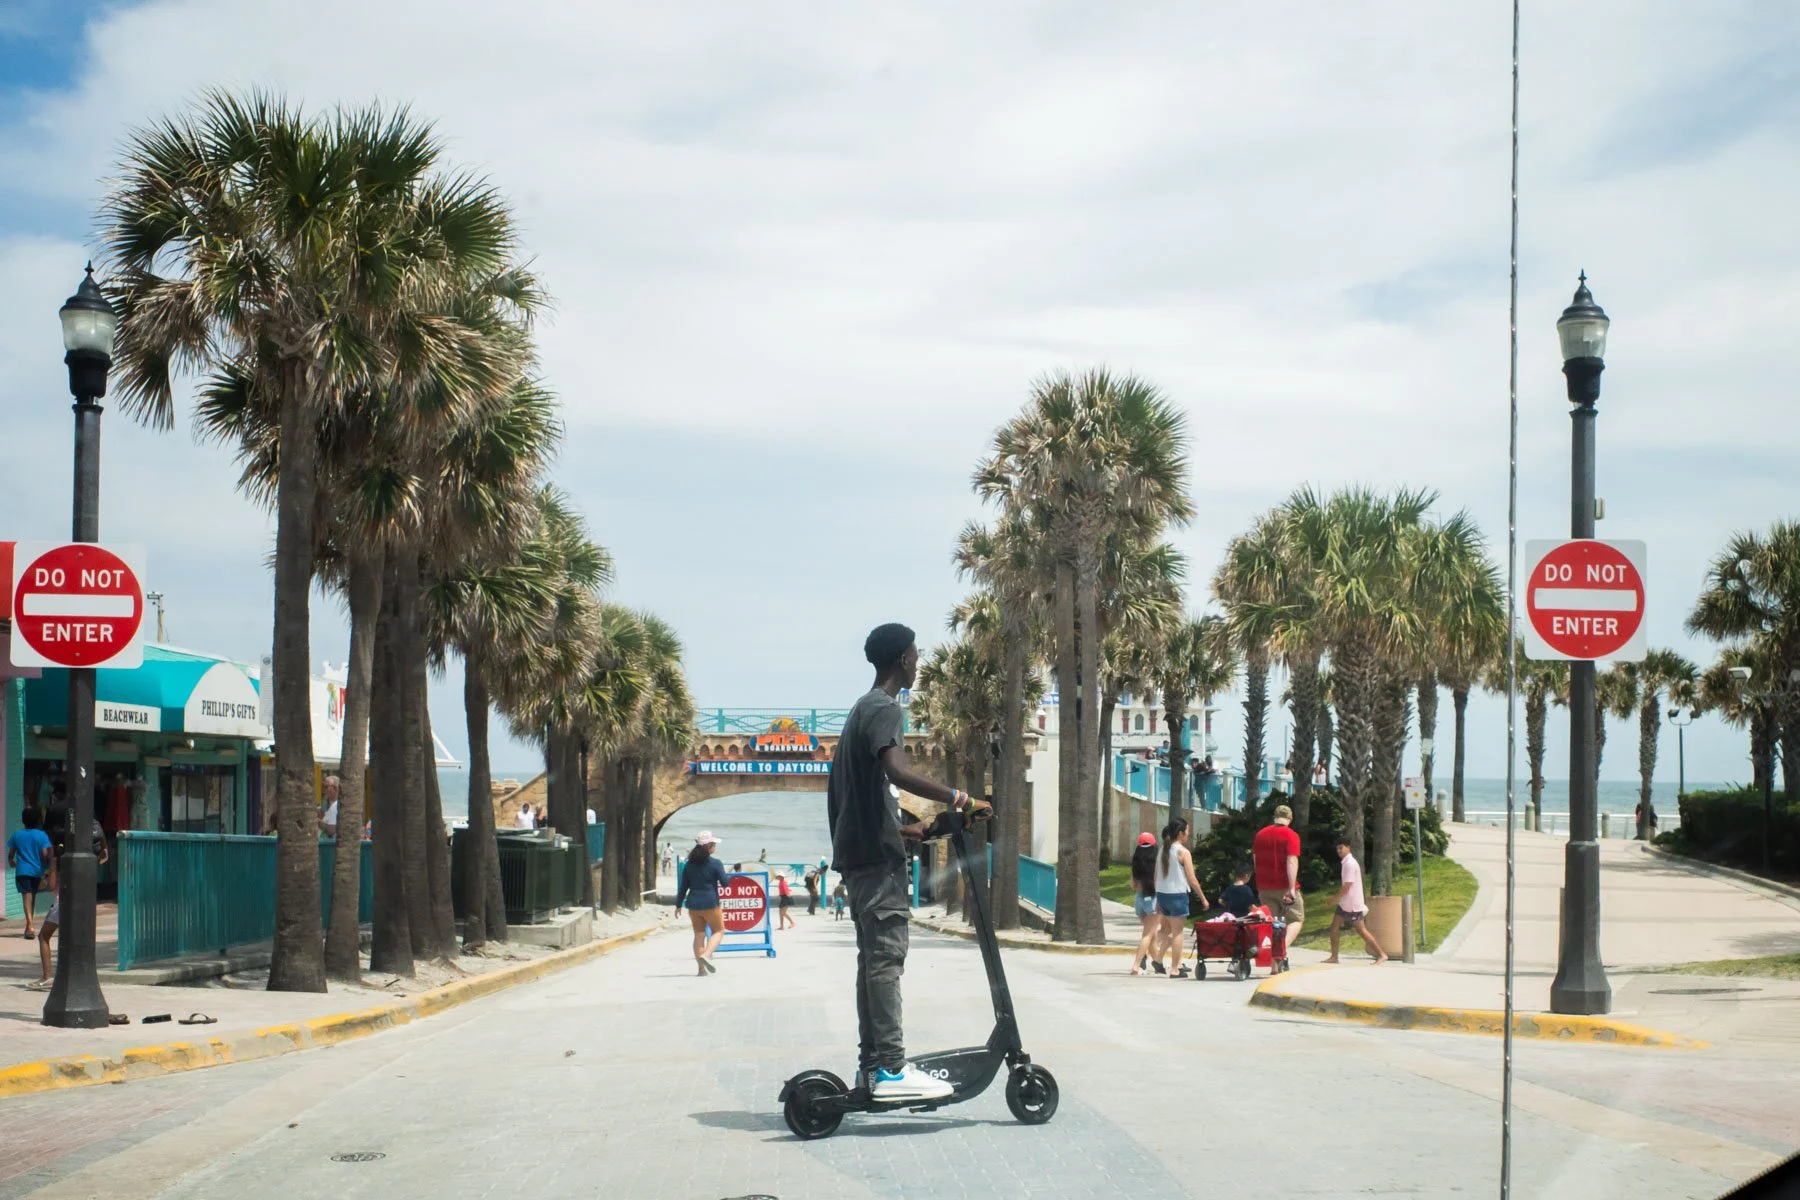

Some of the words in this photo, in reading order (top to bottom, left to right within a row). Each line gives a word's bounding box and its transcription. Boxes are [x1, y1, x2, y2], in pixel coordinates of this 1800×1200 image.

[34, 568, 66, 587] DO
[81, 569, 125, 588] NOT
[1545, 564, 1573, 582] DO
[1586, 564, 1627, 583] NOT
[42, 623, 114, 643] ENTER
[1552, 616, 1618, 636] ENTER
[103, 709, 149, 725] BEACHWEAR
[201, 700, 235, 718] PHILLIP'S
[236, 704, 256, 720] GIFTS
[700, 762, 753, 773] WELCOME
[758, 762, 772, 773] TO
[777, 762, 829, 773] DAYTONA
[718, 887, 732, 896] DO
[738, 886, 758, 895] NOT
[722, 911, 755, 921] ENTER
